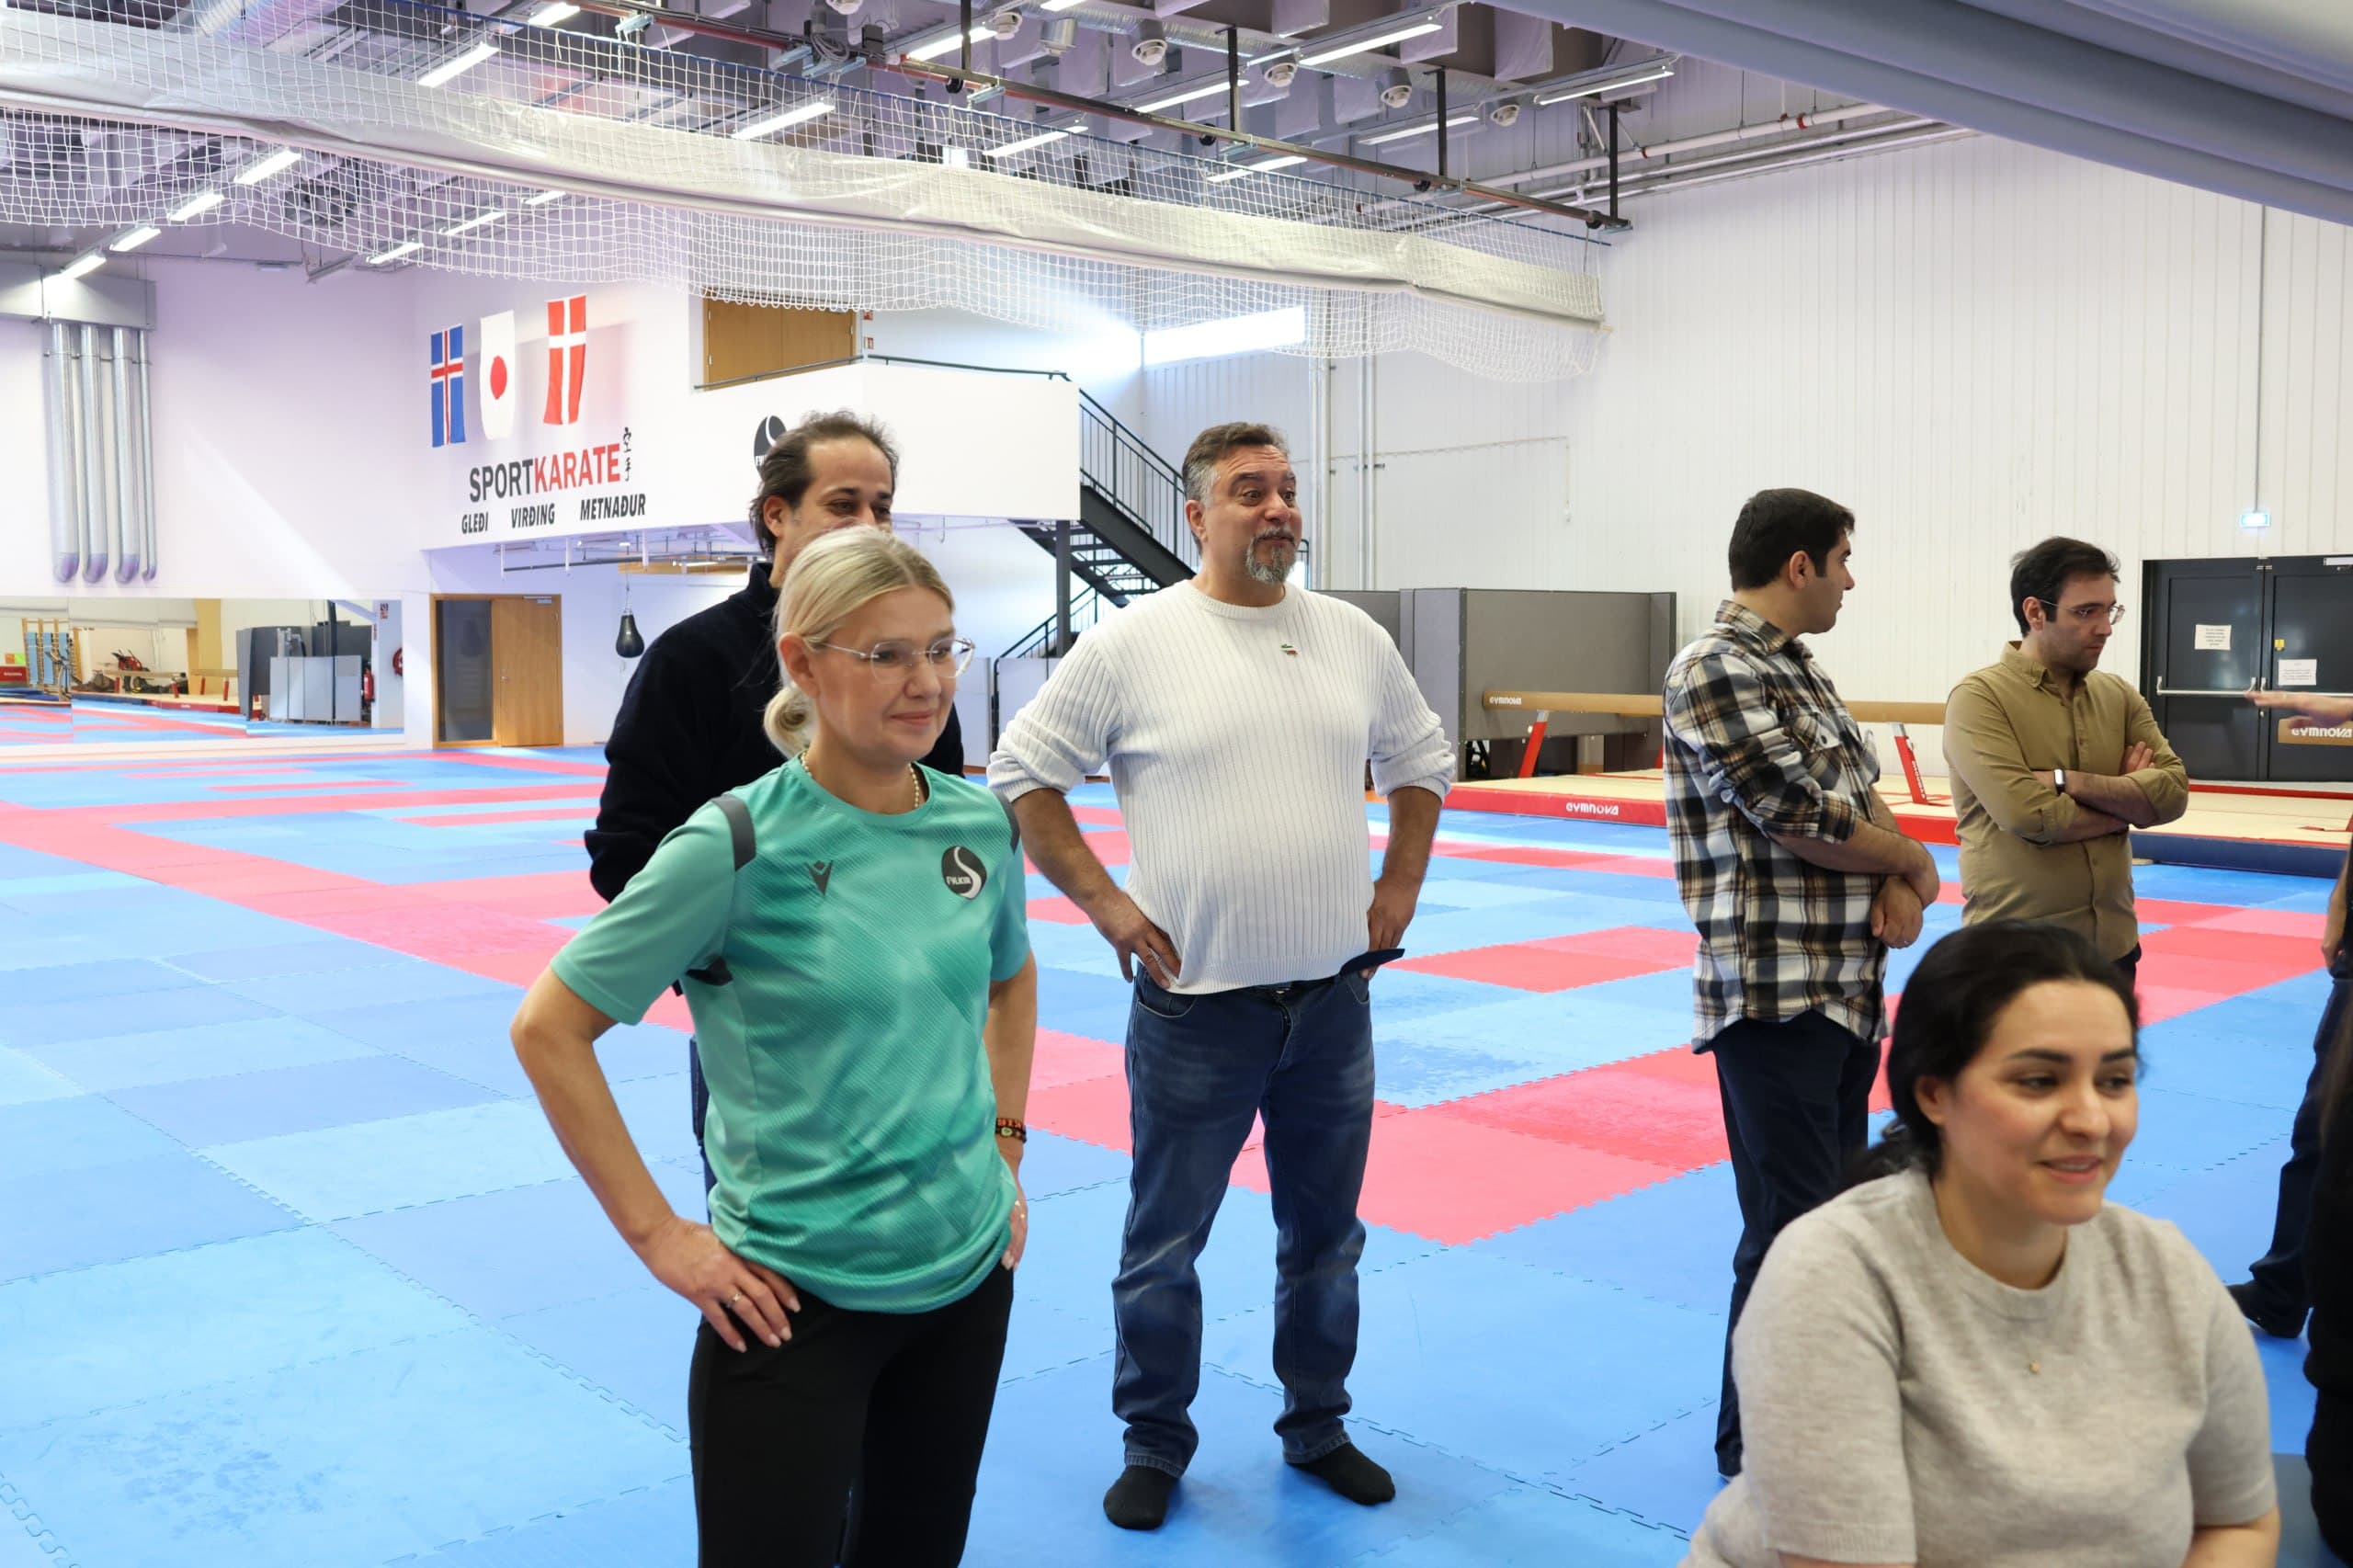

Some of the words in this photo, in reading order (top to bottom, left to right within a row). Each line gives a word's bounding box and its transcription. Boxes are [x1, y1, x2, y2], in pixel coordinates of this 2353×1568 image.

[470, 443, 620, 503] SPORTKARATE
[461, 513, 489, 534] GLEÐI
[511, 504, 555, 528] VIRÐING
[580, 494, 646, 521] METNAÐUR
[1565, 801, 1620, 816] GYMNOVA
